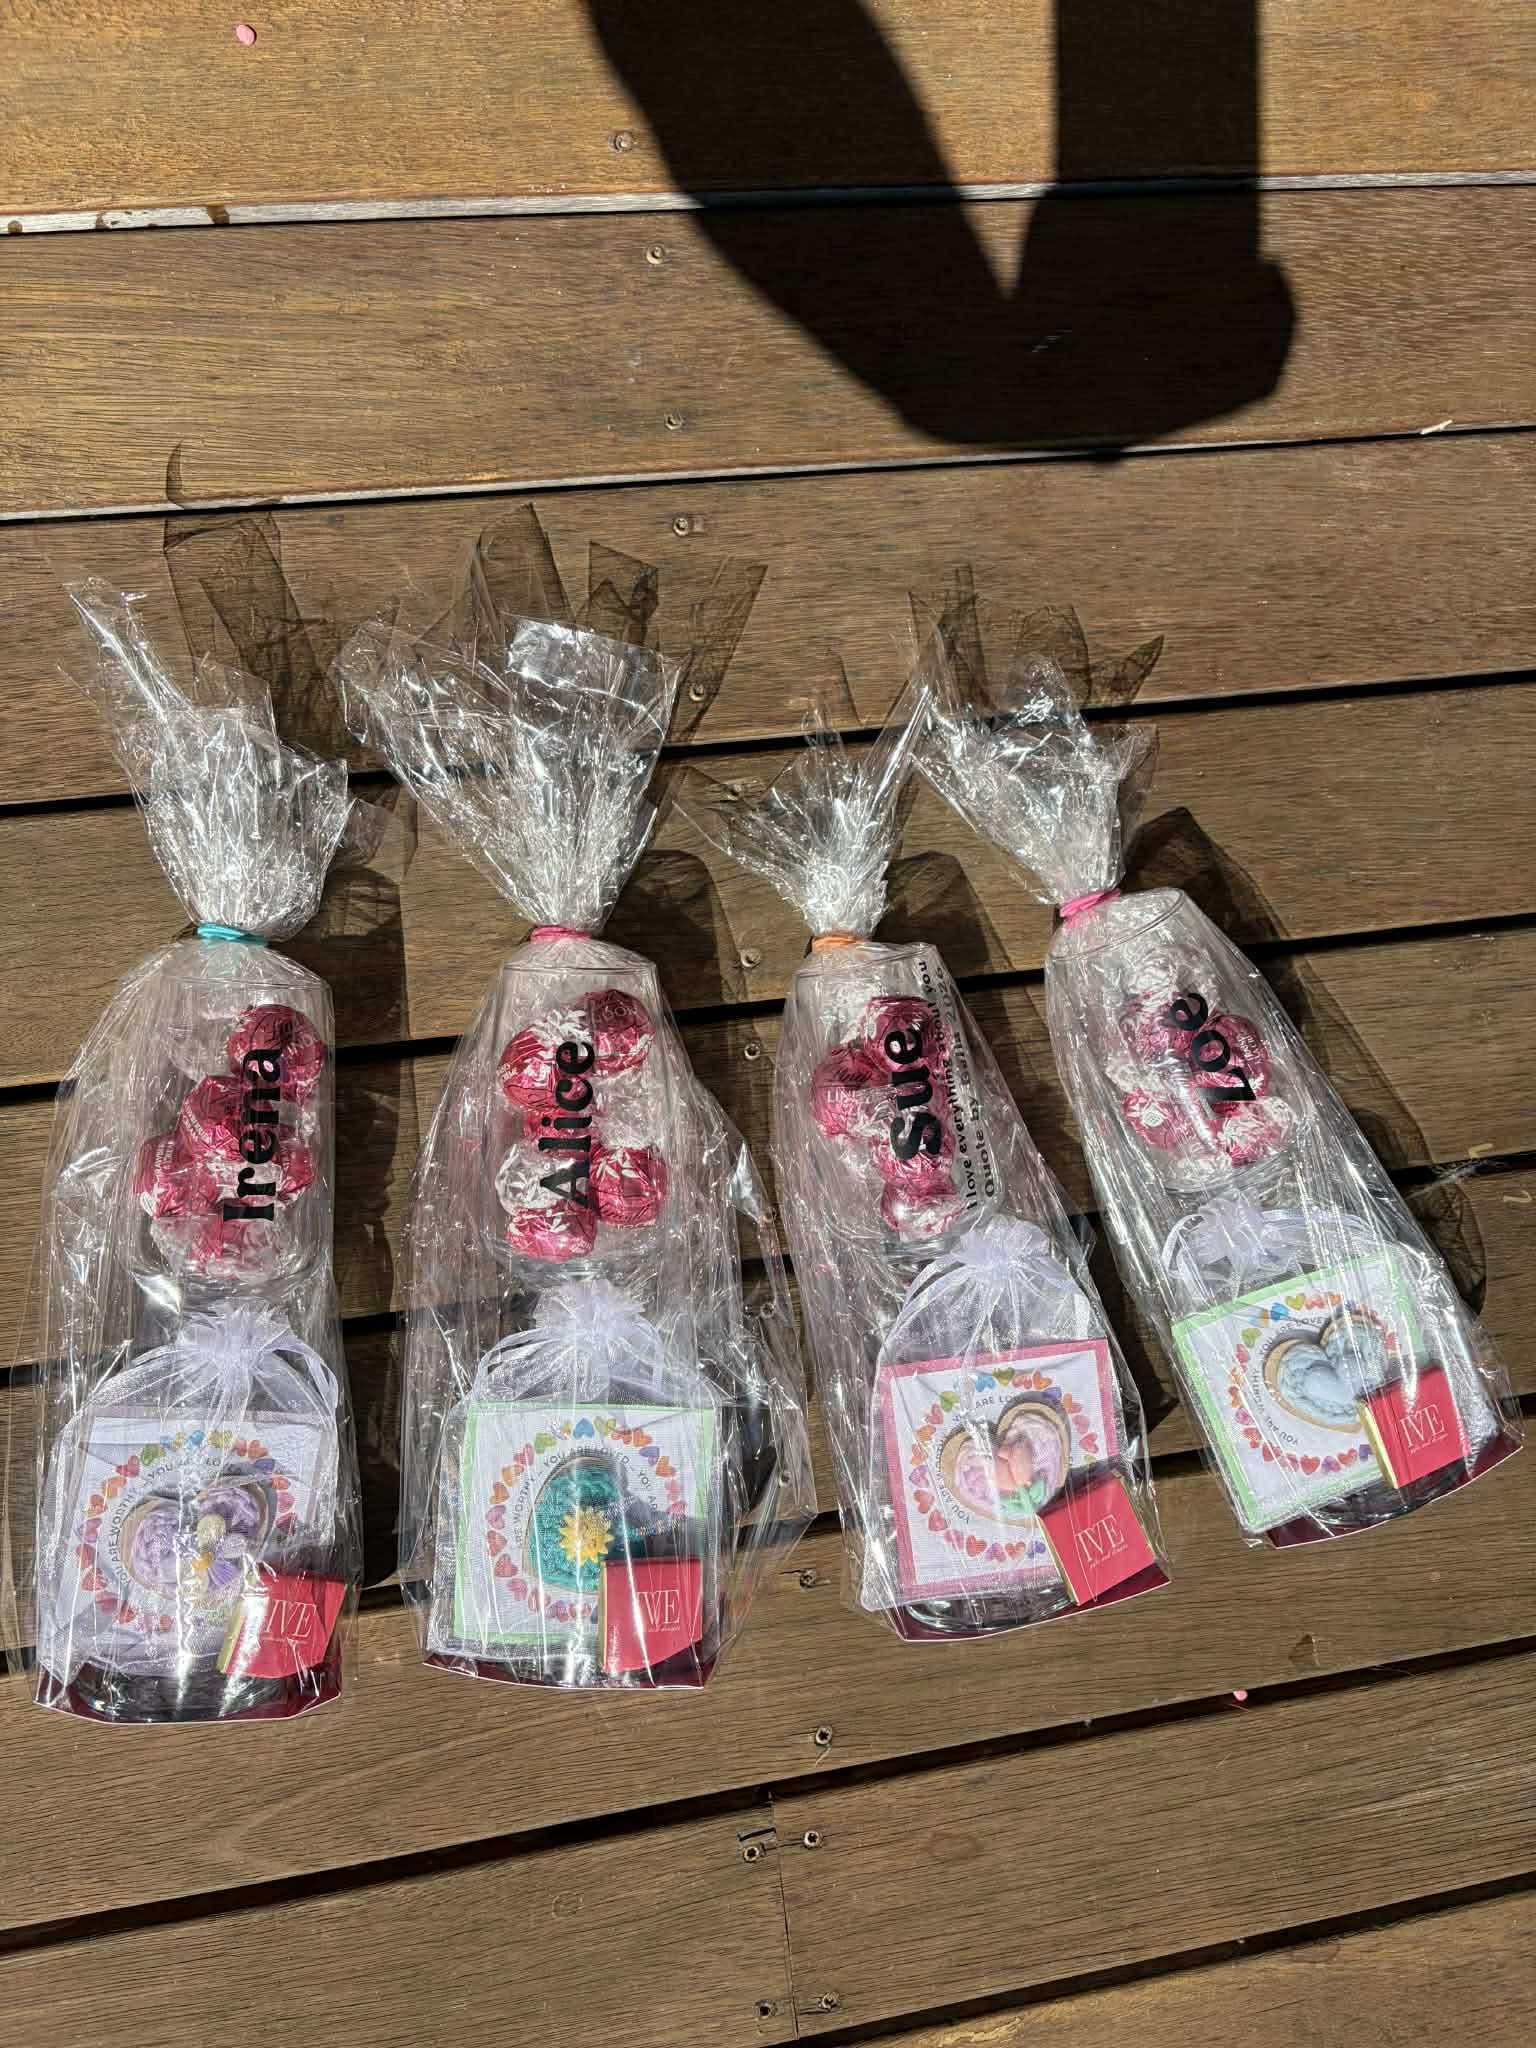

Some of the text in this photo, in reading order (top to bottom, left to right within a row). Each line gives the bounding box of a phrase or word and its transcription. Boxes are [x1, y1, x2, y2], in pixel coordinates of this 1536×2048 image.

[919, 960, 936, 993] you
[928, 1002, 946, 1052] about
[1170, 993, 1256, 1120] Zoe
[884, 1027, 942, 1160] Sue
[943, 1059, 967, 1153] everything
[222, 1049, 282, 1222] Irena
[538, 1041, 595, 1208] Alice
[963, 1159, 977, 1199] love
[976, 1129, 994, 1198] Quote
[1259, 1336, 1273, 1360] YOU
[1296, 1316, 1325, 1328] LOVE
[975, 1396, 996, 1409] ARE
[1399, 1404, 1448, 1449] IVE
[952, 1506, 970, 1525] YOU
[1075, 1514, 1125, 1563] IVE
